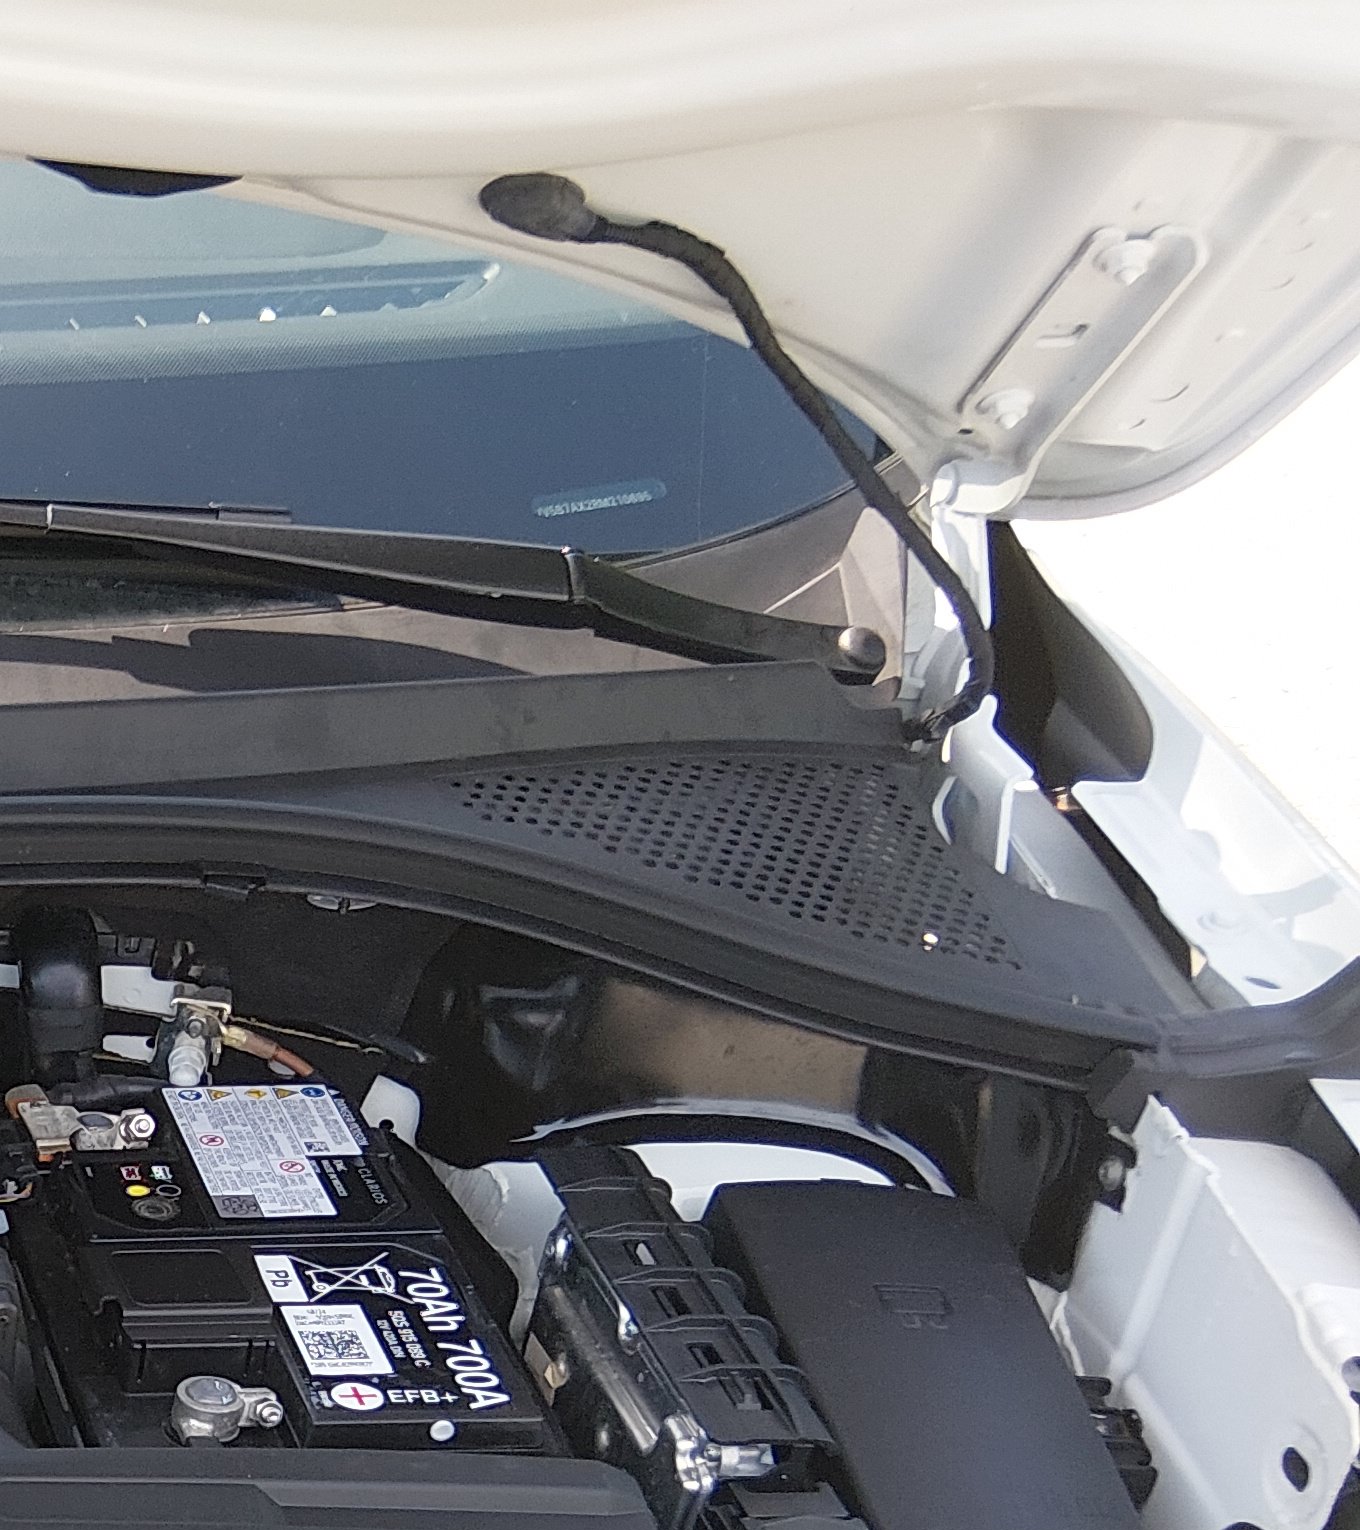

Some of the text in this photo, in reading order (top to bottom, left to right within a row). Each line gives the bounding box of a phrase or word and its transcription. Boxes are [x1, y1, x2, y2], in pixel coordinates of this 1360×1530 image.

[358, 1168, 388, 1205] CLARIOS
[265, 1269, 293, 1288] Pb
[397, 1267, 511, 1410] 70Ah 700A
[414, 1359, 432, 1368] C
[386, 1389, 460, 1403] EFB+
